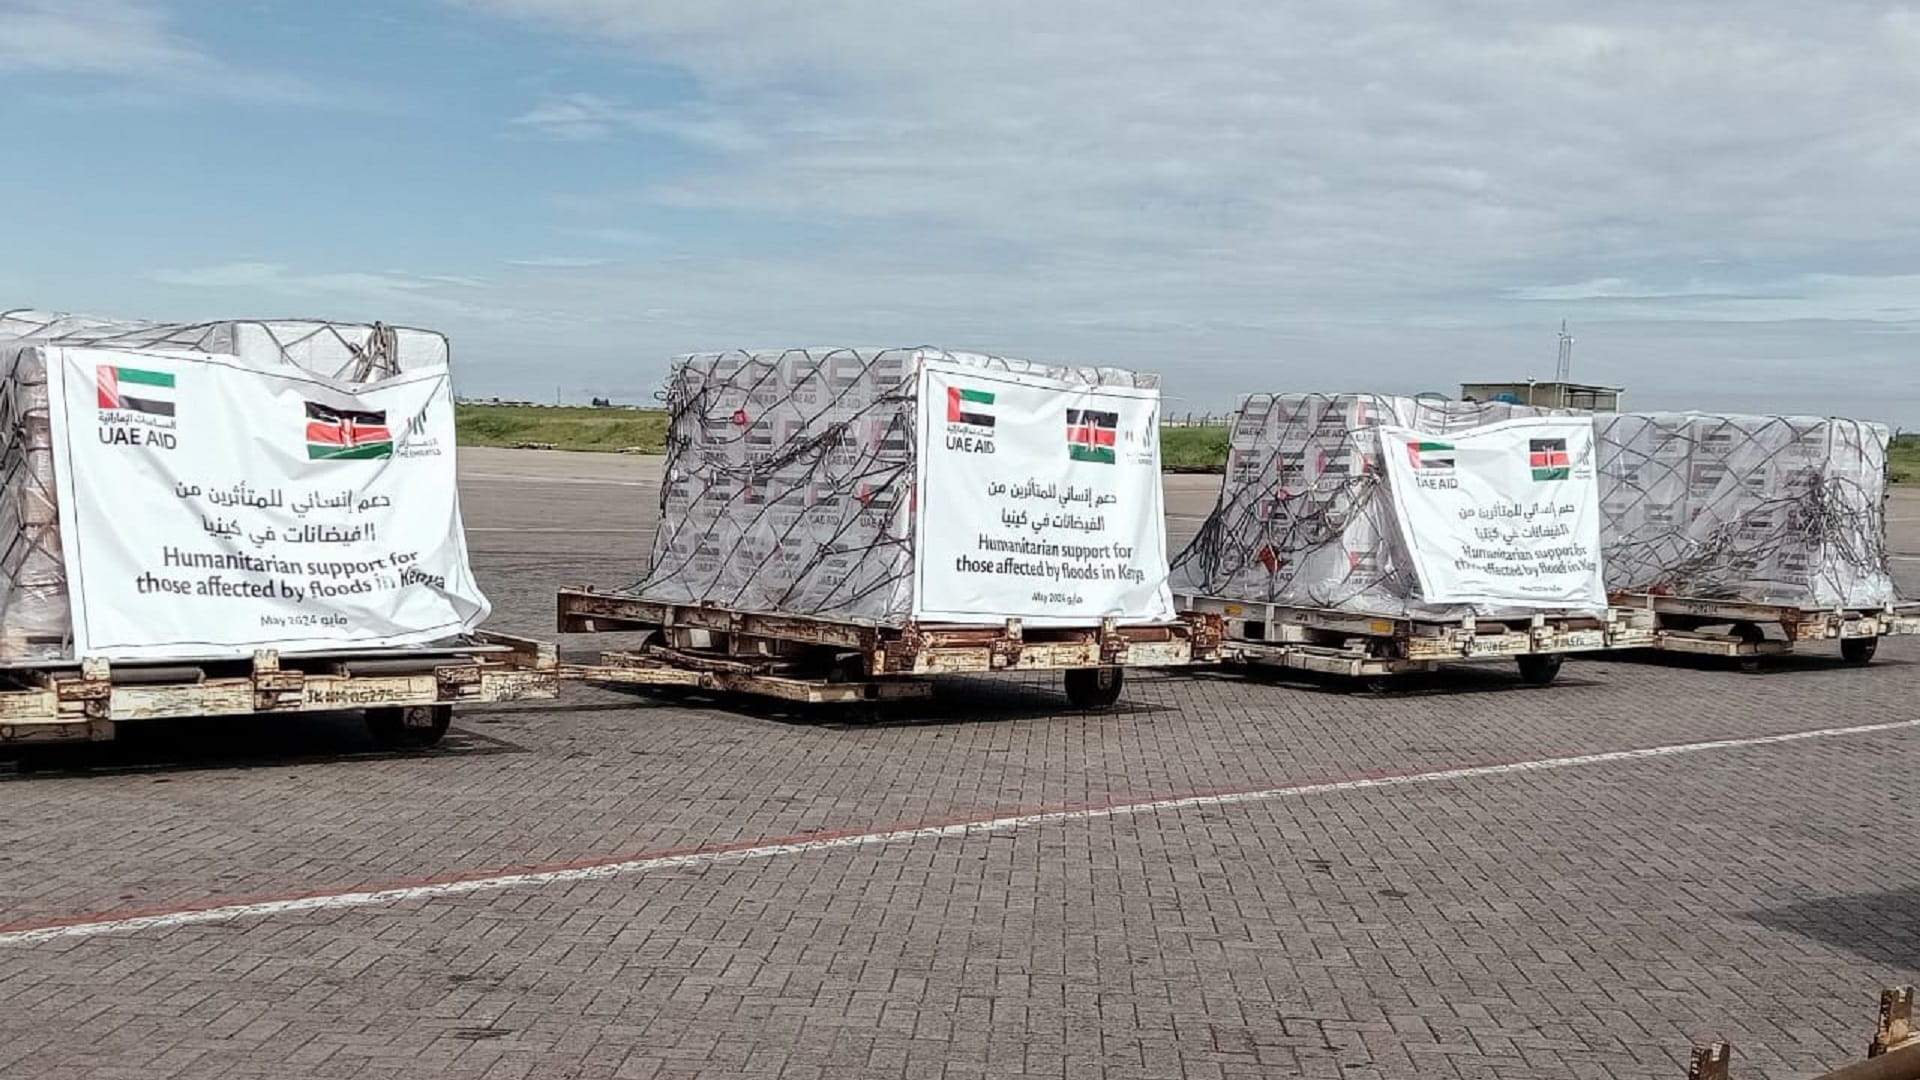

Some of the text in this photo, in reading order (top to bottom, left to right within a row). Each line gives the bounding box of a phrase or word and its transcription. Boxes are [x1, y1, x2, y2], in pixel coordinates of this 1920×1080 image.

[98, 427, 177, 450] UAE AID
[946, 435, 996, 454] UAE AID
[988, 476, 1117, 508] دعم إنساني للمتأثرين من
[1439, 478, 1458, 490] AID
[175, 480, 391, 518] دعم إنساني للمتأثرين من
[201, 514, 377, 549] الفيضانات في كينيا
[1001, 507, 1105, 535] الفيضانات في كينيا
[978, 533, 1134, 563] Humanitarian support for
[1462, 544, 1533, 561] Humanitarian
[163, 546, 419, 580] Humanitarian support for
[956, 554, 994, 574] those
[996, 557, 1045, 577] affected
[1046, 560, 1060, 582] by
[1061, 562, 1100, 580] floods
[1101, 563, 1116, 580] in
[136, 571, 192, 597] those
[196, 575, 276, 599] affected
[281, 580, 304, 604] by
[310, 579, 373, 599] floods
[374, 573, 396, 591] in
[260, 614, 286, 628] May
